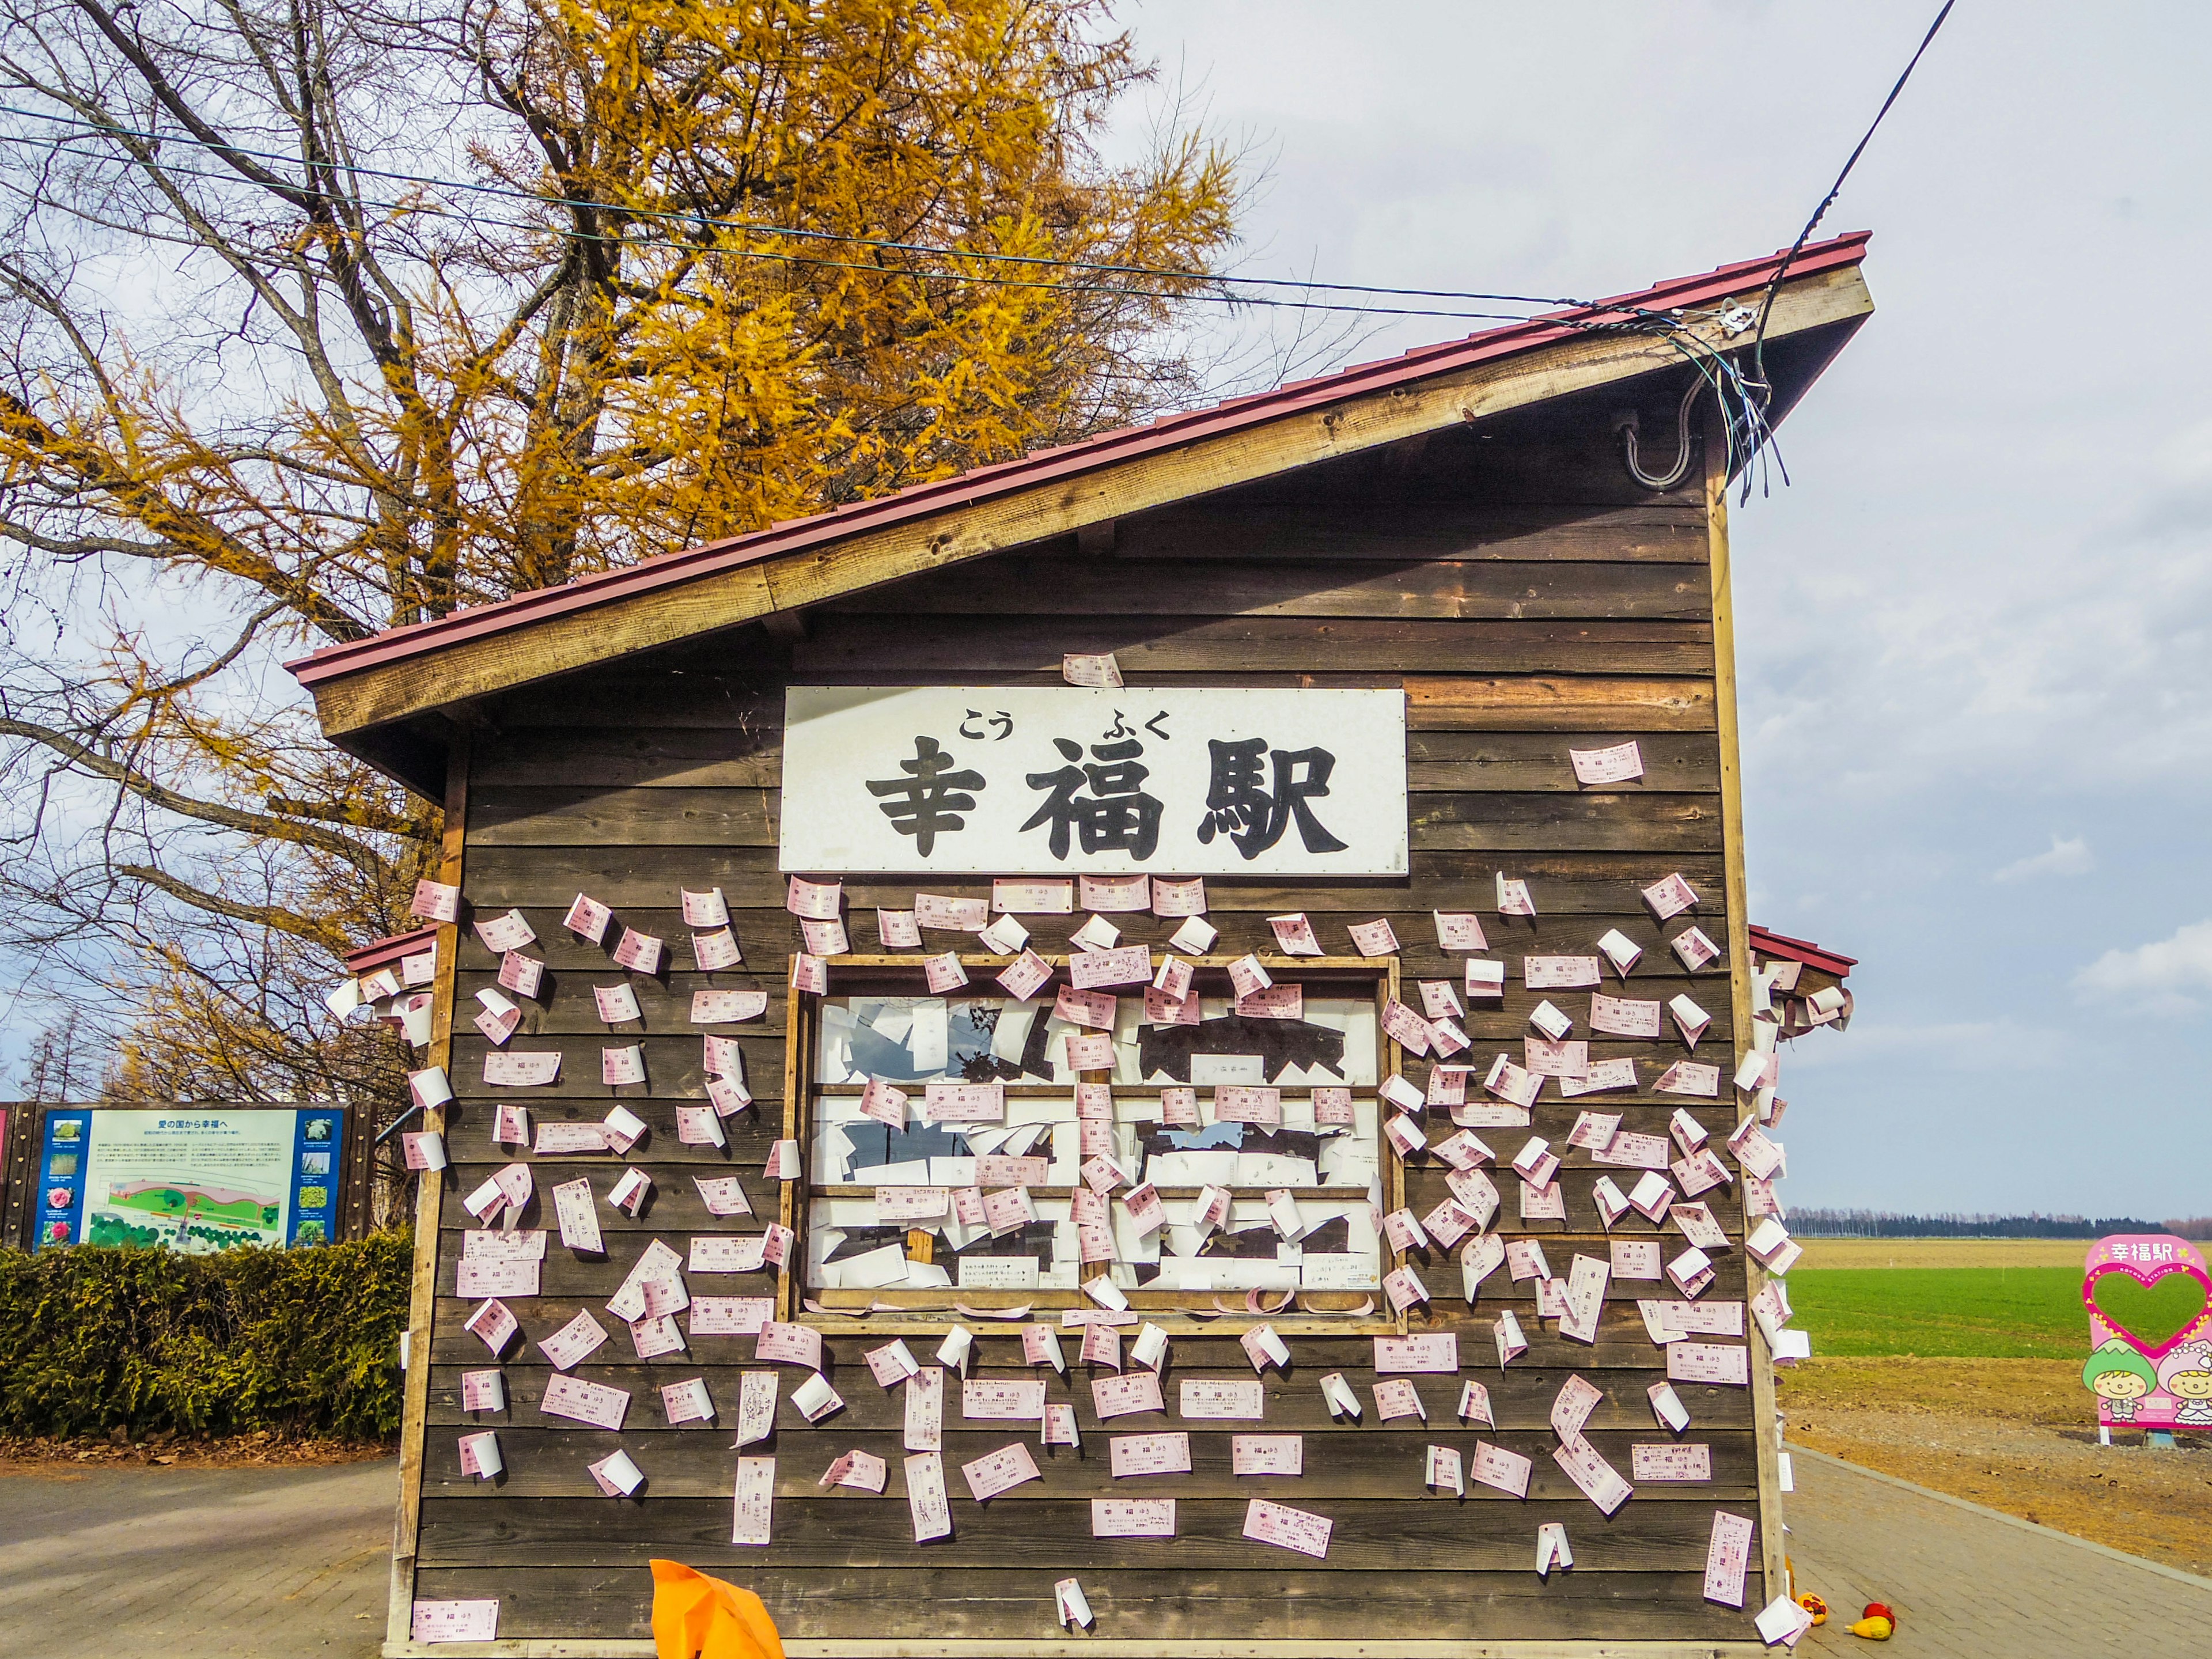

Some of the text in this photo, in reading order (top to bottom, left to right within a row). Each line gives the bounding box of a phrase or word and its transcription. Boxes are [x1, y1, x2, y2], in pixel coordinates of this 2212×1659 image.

[959, 709, 1170, 741] こう ふく
[865, 736, 1350, 861] 幸福駅
[158, 1120, 228, 1128] 愛の国から幸福へ
[2111, 1243, 2173, 1262] 幸福駅
